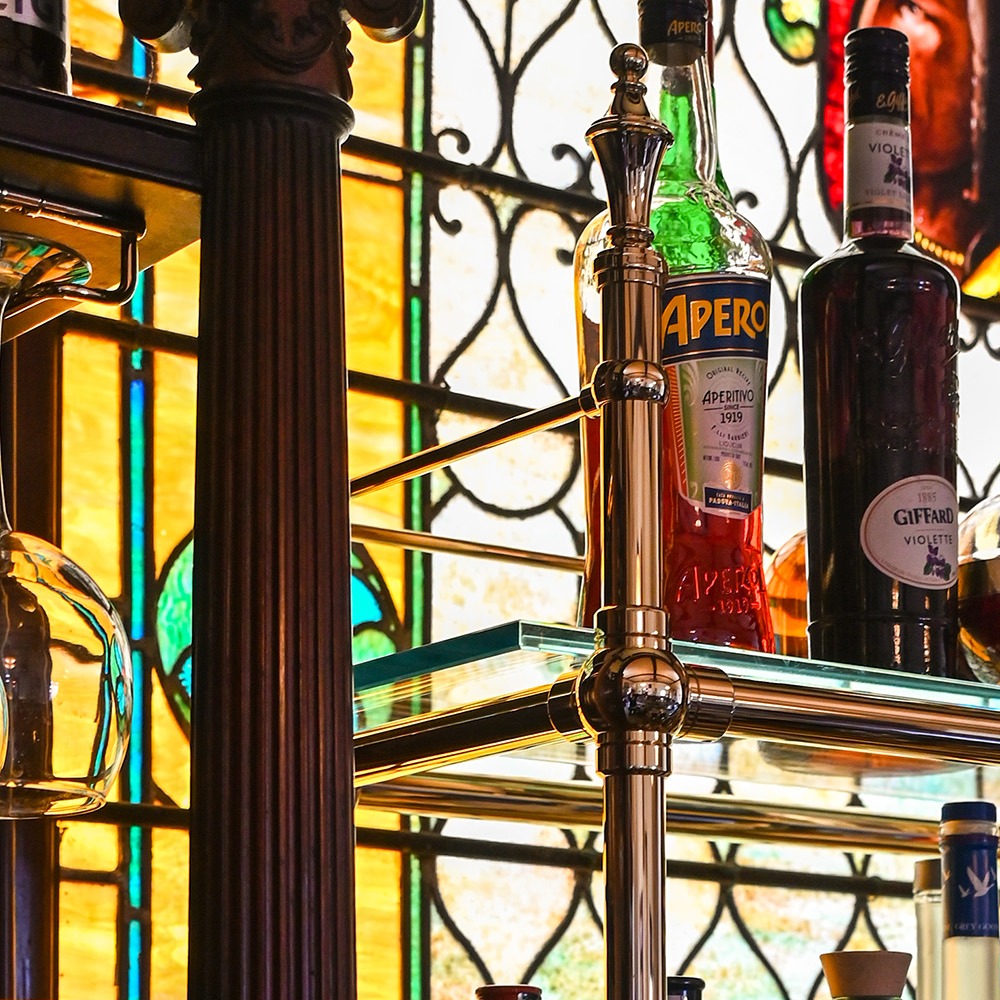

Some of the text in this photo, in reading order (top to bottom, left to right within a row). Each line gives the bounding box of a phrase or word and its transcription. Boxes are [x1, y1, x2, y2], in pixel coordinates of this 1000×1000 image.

[661, 293, 769, 350] APERO
[702, 389, 754, 405] APERITIVO
[721, 412, 743, 424] 1919
[893, 508, 954, 525] GIFFARD
[903, 535, 953, 545] VIOLETTE
